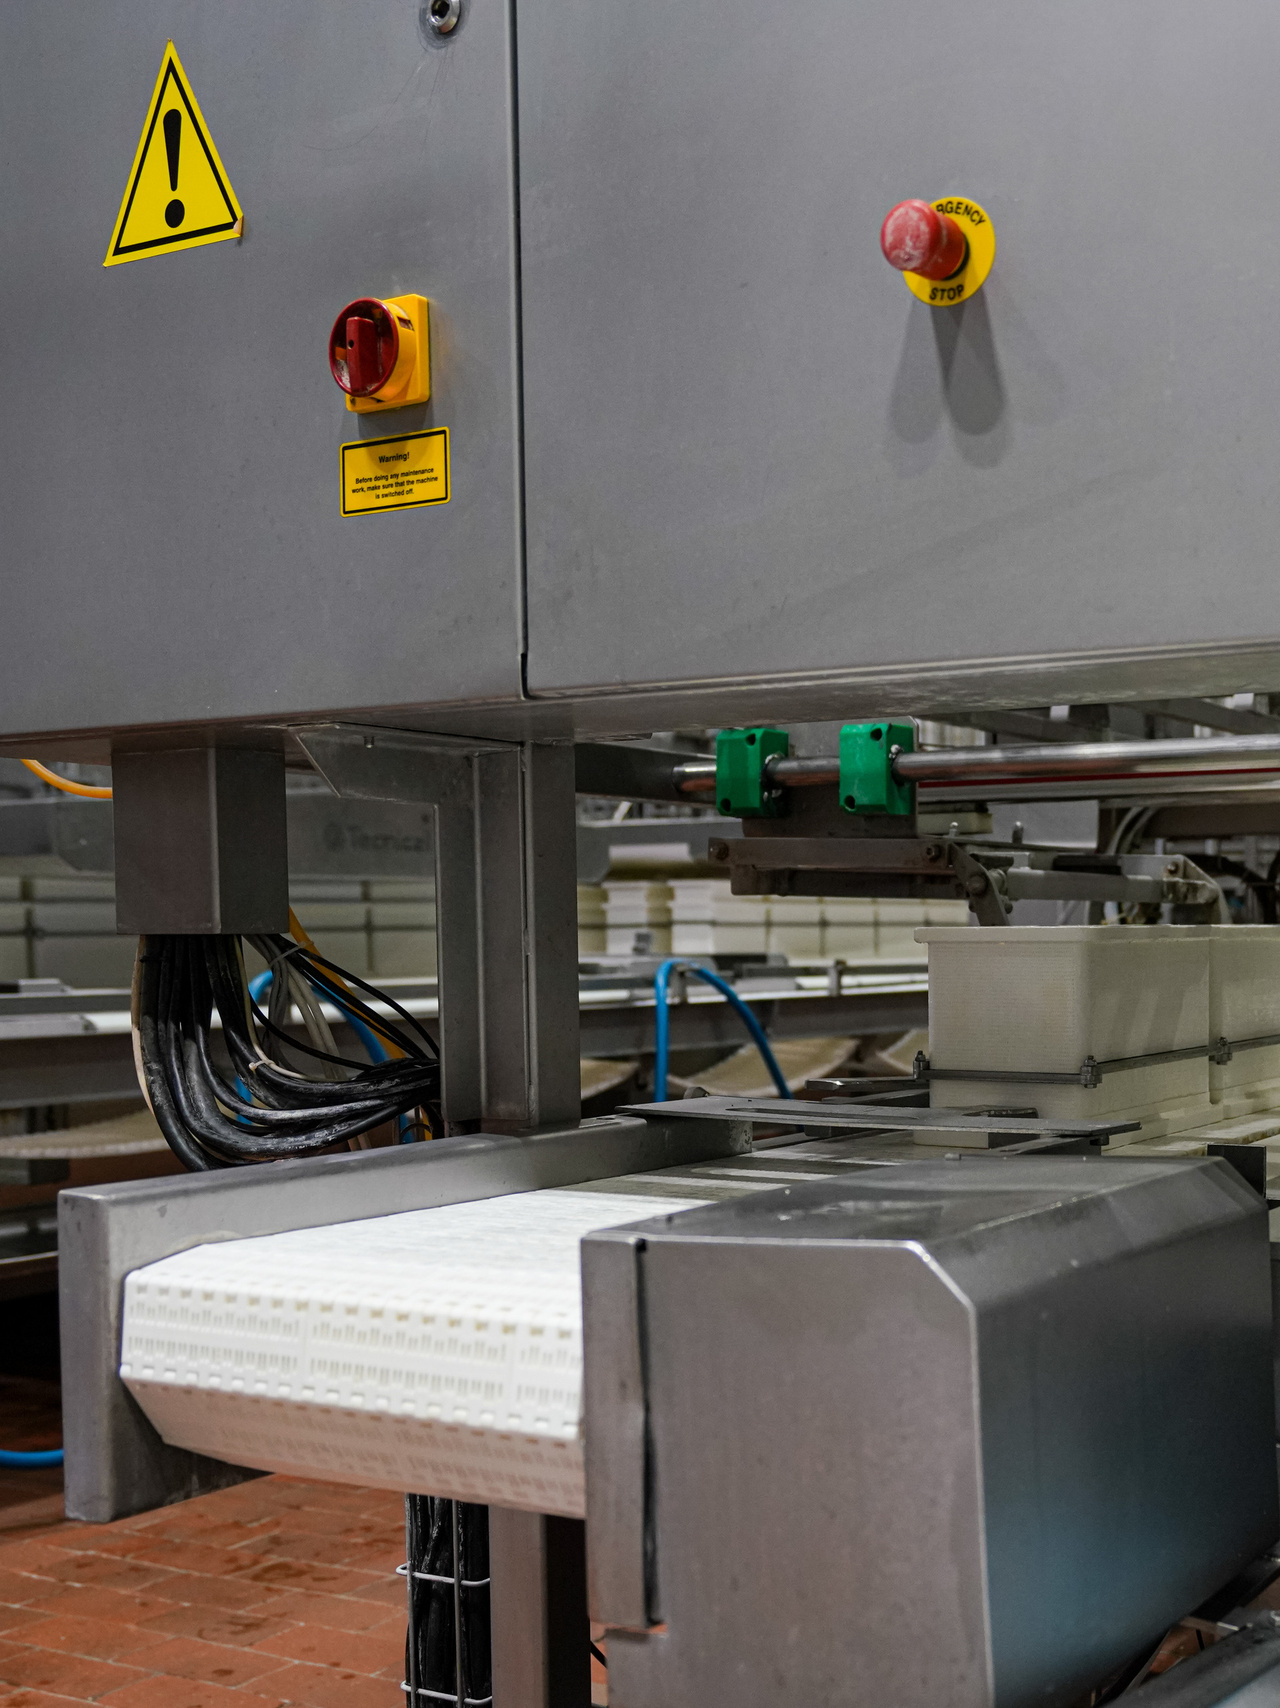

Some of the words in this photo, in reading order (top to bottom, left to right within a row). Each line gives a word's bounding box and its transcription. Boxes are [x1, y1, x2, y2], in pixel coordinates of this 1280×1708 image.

[936, 201, 986, 226] RGENCY
[929, 284, 964, 301] STOP
[378, 451, 410, 463] Warning!
[355, 476, 373, 484] Before
[374, 473, 389, 481] doing
[400, 467, 434, 478] maintenance
[351, 486, 366, 494] work,
[366, 484, 381, 492] make
[416, 476, 438, 484] machine
[381, 489, 405, 498] switched
